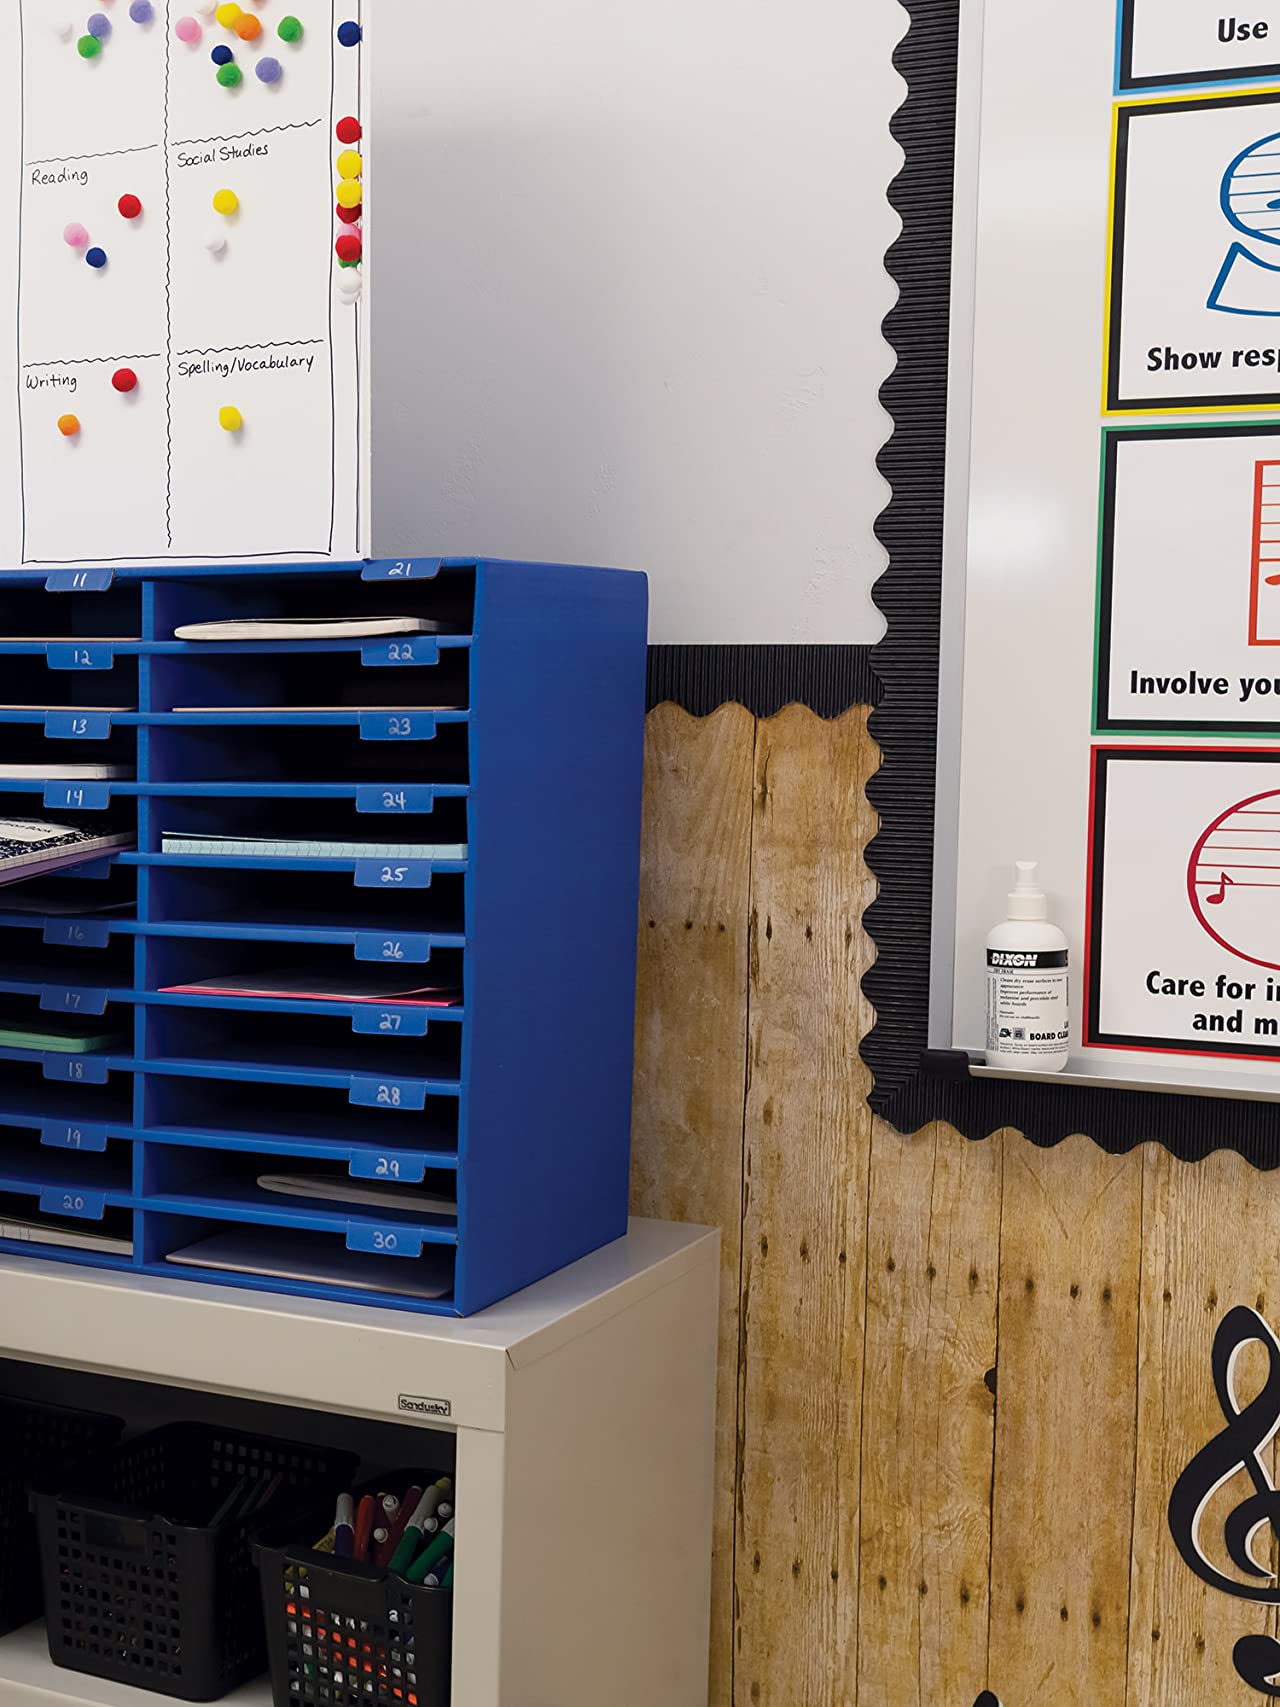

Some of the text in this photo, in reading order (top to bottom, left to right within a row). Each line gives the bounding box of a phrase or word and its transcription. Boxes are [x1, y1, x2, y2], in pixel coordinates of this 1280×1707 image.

[1218, 17, 1269, 43] Use
[177, 143, 269, 168] Social Studies
[31, 167, 89, 186] Reading
[176, 353, 315, 378] Spelling/Vocabulary
[1147, 346, 1280, 373] Show res
[26, 374, 77, 393] Writing
[387, 562, 411, 577] 21
[72, 572, 87, 588] 11
[74, 649, 93, 666] 12
[388, 643, 414, 660] 22
[1130, 670, 1229, 695] Involve
[72, 719, 87, 734] 13
[388, 717, 411, 736] 23
[66, 789, 83, 806] 14
[382, 791, 406, 810] 24
[381, 866, 410, 882] 25
[67, 925, 85, 941] 16
[382, 941, 404, 959] 26
[991, 952, 1038, 967] DIXON
[1146, 970, 1280, 1002] Care for i
[65, 992, 81, 1009] 17
[379, 1013, 401, 1030] 27
[1192, 1009, 1243, 1033] and
[1029, 1032, 1056, 1041] BOARD
[68, 1061, 84, 1079] 18
[377, 1085, 401, 1106] 28
[67, 1127, 81, 1147] 19
[375, 1158, 400, 1177] 29
[63, 1194, 84, 1210] 20
[373, 1231, 397, 1249] 30
[400, 1398, 448, 1414] Sandusky
